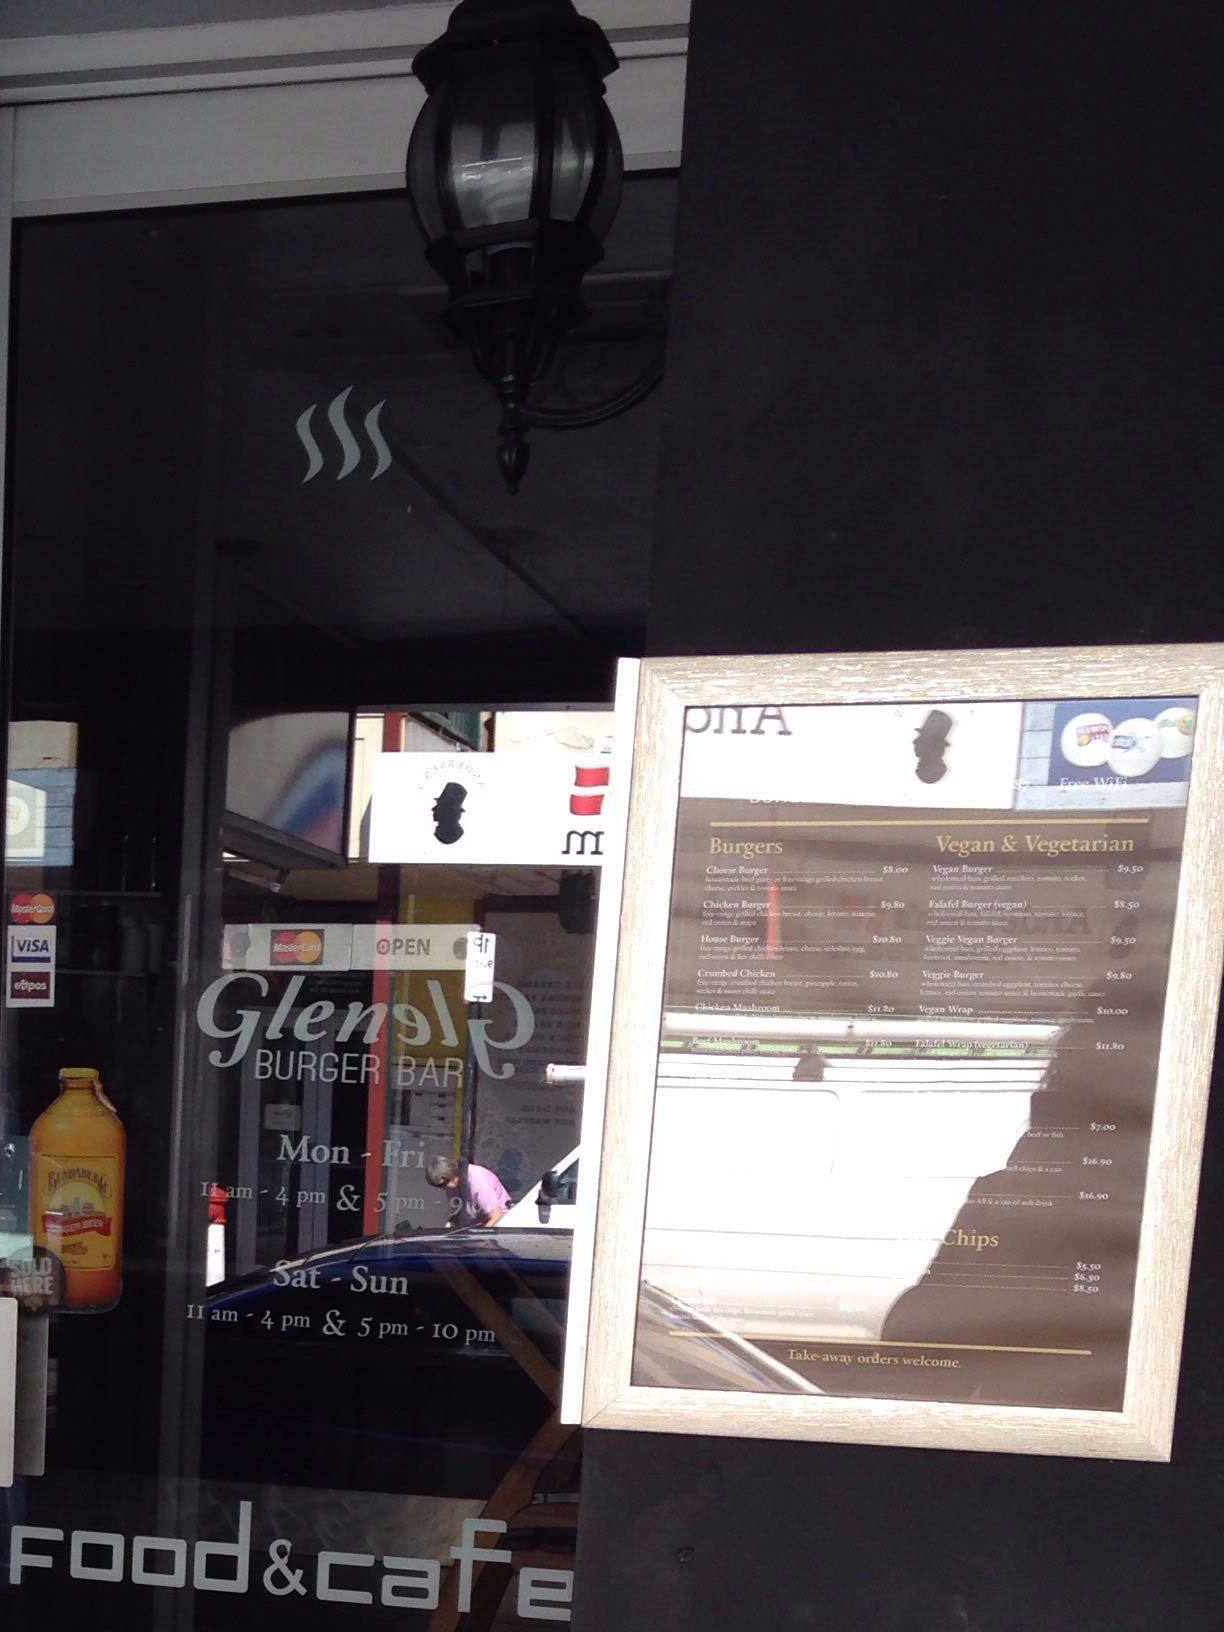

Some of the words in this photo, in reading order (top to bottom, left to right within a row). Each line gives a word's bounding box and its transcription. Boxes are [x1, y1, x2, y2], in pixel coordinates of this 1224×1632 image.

[709, 837, 784, 859] Burgers
[935, 834, 995, 858] Vegan
[1001, 835, 1018, 852] &
[1024, 833, 1135, 858] Vegetarian
[706, 866, 736, 875] Cheese
[738, 866, 769, 877] Burger
[882, 865, 909, 875] $8.00
[932, 865, 960, 876] Vegan
[962, 865, 993, 876] Burger
[1117, 865, 1144, 875] $9.50
[703, 900, 739, 910] Chicken
[741, 900, 771, 912] Burger
[880, 901, 905, 911] $9.80
[929, 900, 959, 909] Falafel
[961, 900, 993, 911] Burger
[994, 900, 1027, 911] (vegan)
[1113, 900, 1140, 910] $8.50
[17, 939, 49, 952] VISA
[729, 935, 760, 946] Burger
[872, 935, 902, 945] $10.80
[926, 935, 954, 946] Veggie
[957, 935, 984, 946] Vegan
[986, 936, 1017, 946] Burger
[1110, 936, 1136, 946] $9.50
[376, 938, 431, 956] OPEN
[697, 969, 739, 978] Crumbed
[739, 969, 776, 978] Chicken
[869, 970, 898, 979] $10.80
[922, 970, 952, 981] Veggie
[954, 970, 984, 982] Burger
[1106, 971, 1133, 981] $9.80
[14, 978, 47, 992] eftpos
[919, 1005, 945, 1016] Vegan
[948, 1005, 974, 1016] Wrap
[1096, 1006, 1129, 1016] $10.00
[1096, 1041, 1125, 1051] $11.80
[253, 1049, 382, 1085] BURGER
[397, 1054, 465, 1089] BAR
[1089, 1122, 1116, 1132] $7.00
[276, 1134, 351, 1165] Mon
[381, 1140, 425, 1169] Fri
[1082, 1156, 1112, 1167] $16.90
[226, 1185, 252, 1199] am
[275, 1186, 289, 1207] 4
[296, 1190, 326, 1207] pm
[336, 1185, 361, 1212] &
[374, 1192, 388, 1213] 5
[396, 1194, 426, 1211] pm
[1079, 1191, 1109, 1201] $16.90
[943, 1228, 1000, 1250] Chips
[1076, 1261, 1101, 1271] $5.50
[273, 1261, 321, 1289] Sat
[350, 1266, 409, 1296] Sun
[1074, 1272, 1100, 1282] $6.50
[9, 1277, 54, 1295] HERE
[1073, 1283, 1100, 1294] $8.50
[211, 1308, 238, 1322] am
[260, 1310, 274, 1330] 4
[281, 1313, 311, 1332] pm
[322, 1309, 346, 1337] &
[357, 1317, 373, 1338] 5
[378, 1319, 409, 1338] pm
[432, 1323, 459, 1339] 10
[465, 1327, 496, 1346] pm
[787, 1349, 854, 1366] Take-away
[857, 1352, 900, 1366] orders
[902, 1354, 961, 1369] welcome.
